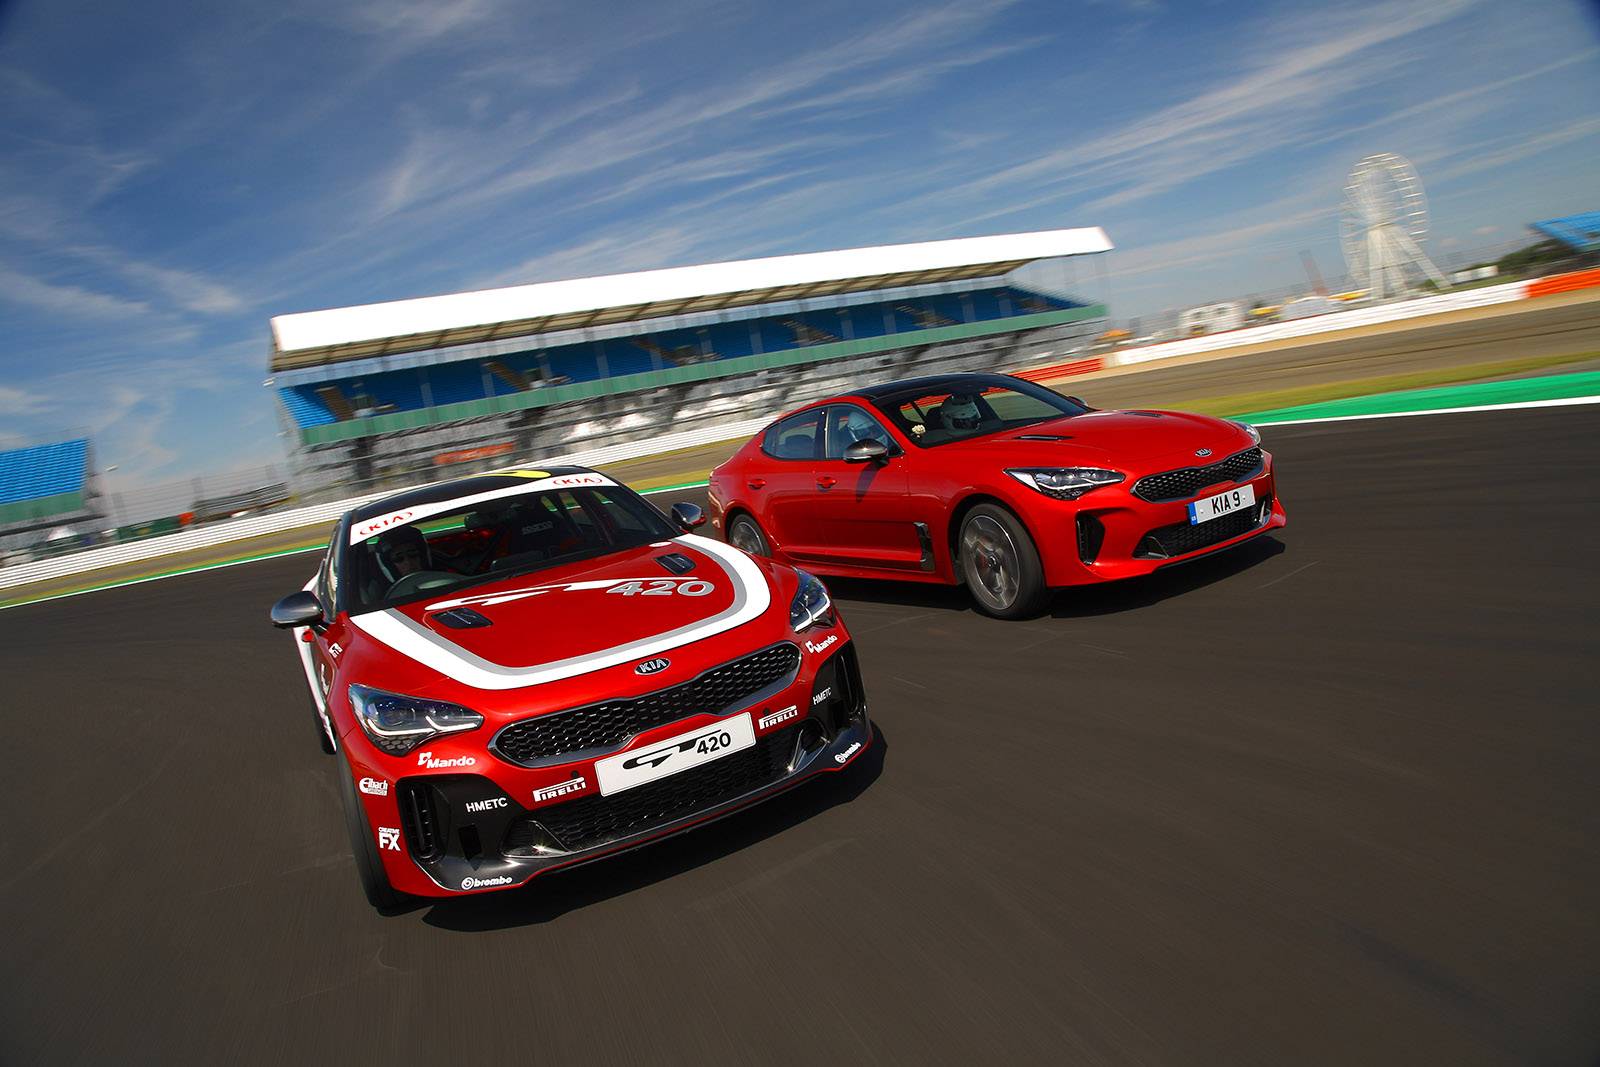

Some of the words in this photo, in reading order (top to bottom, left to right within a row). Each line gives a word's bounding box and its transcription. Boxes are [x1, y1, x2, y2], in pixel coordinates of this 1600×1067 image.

[559, 477, 596, 486] KIA
[1211, 496, 1231, 514] KIA
[1232, 491, 1241, 507] 9
[366, 514, 406, 533] KIA
[606, 580, 715, 596] 420
[639, 658, 667, 673] KIA
[812, 687, 832, 705] HMETC
[758, 705, 798, 730] PIRELLI
[696, 732, 731, 755] 420
[426, 756, 476, 769] Mando
[532, 776, 587, 802] PIRELLI
[466, 797, 508, 813] HMETC
[379, 833, 401, 851] FX
[474, 876, 513, 887] brembo
